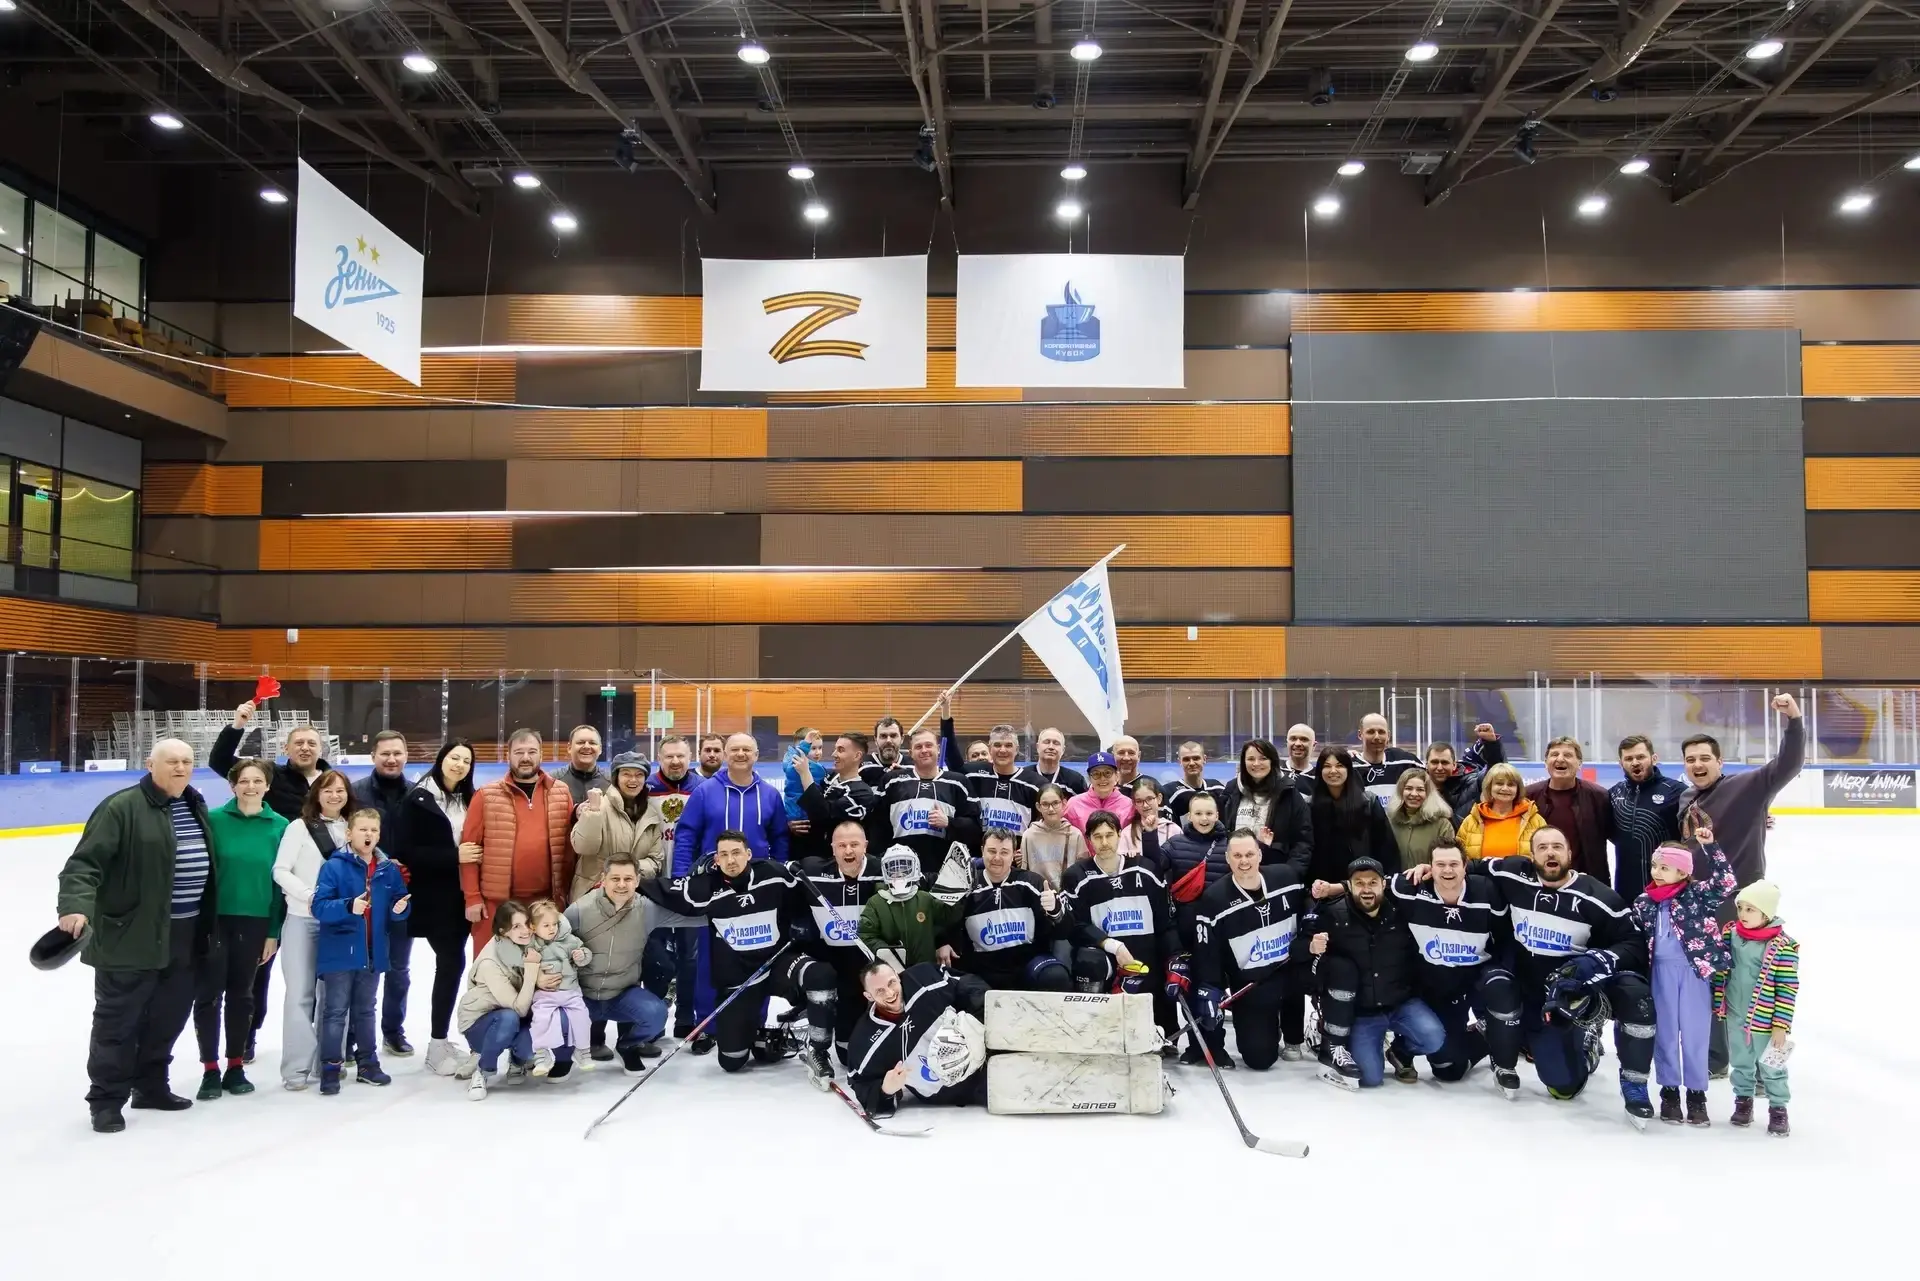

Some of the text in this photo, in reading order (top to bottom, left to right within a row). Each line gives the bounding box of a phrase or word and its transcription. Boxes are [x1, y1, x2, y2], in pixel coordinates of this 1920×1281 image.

[376, 311, 395, 335] 1925
[762, 291, 871, 364] Z
[1096, 753, 1105, 763] LA
[1828, 773, 1912, 792] ANGRY ANIMAL
[1135, 872, 1143, 888] A
[1282, 895, 1290, 911] A
[736, 923, 772, 937] ГАЗПРОМ
[1529, 926, 1572, 945] ГАЗПРОМ
[1064, 995, 1110, 1004] BAUER
[1072, 1102, 1117, 1110] BAUER
